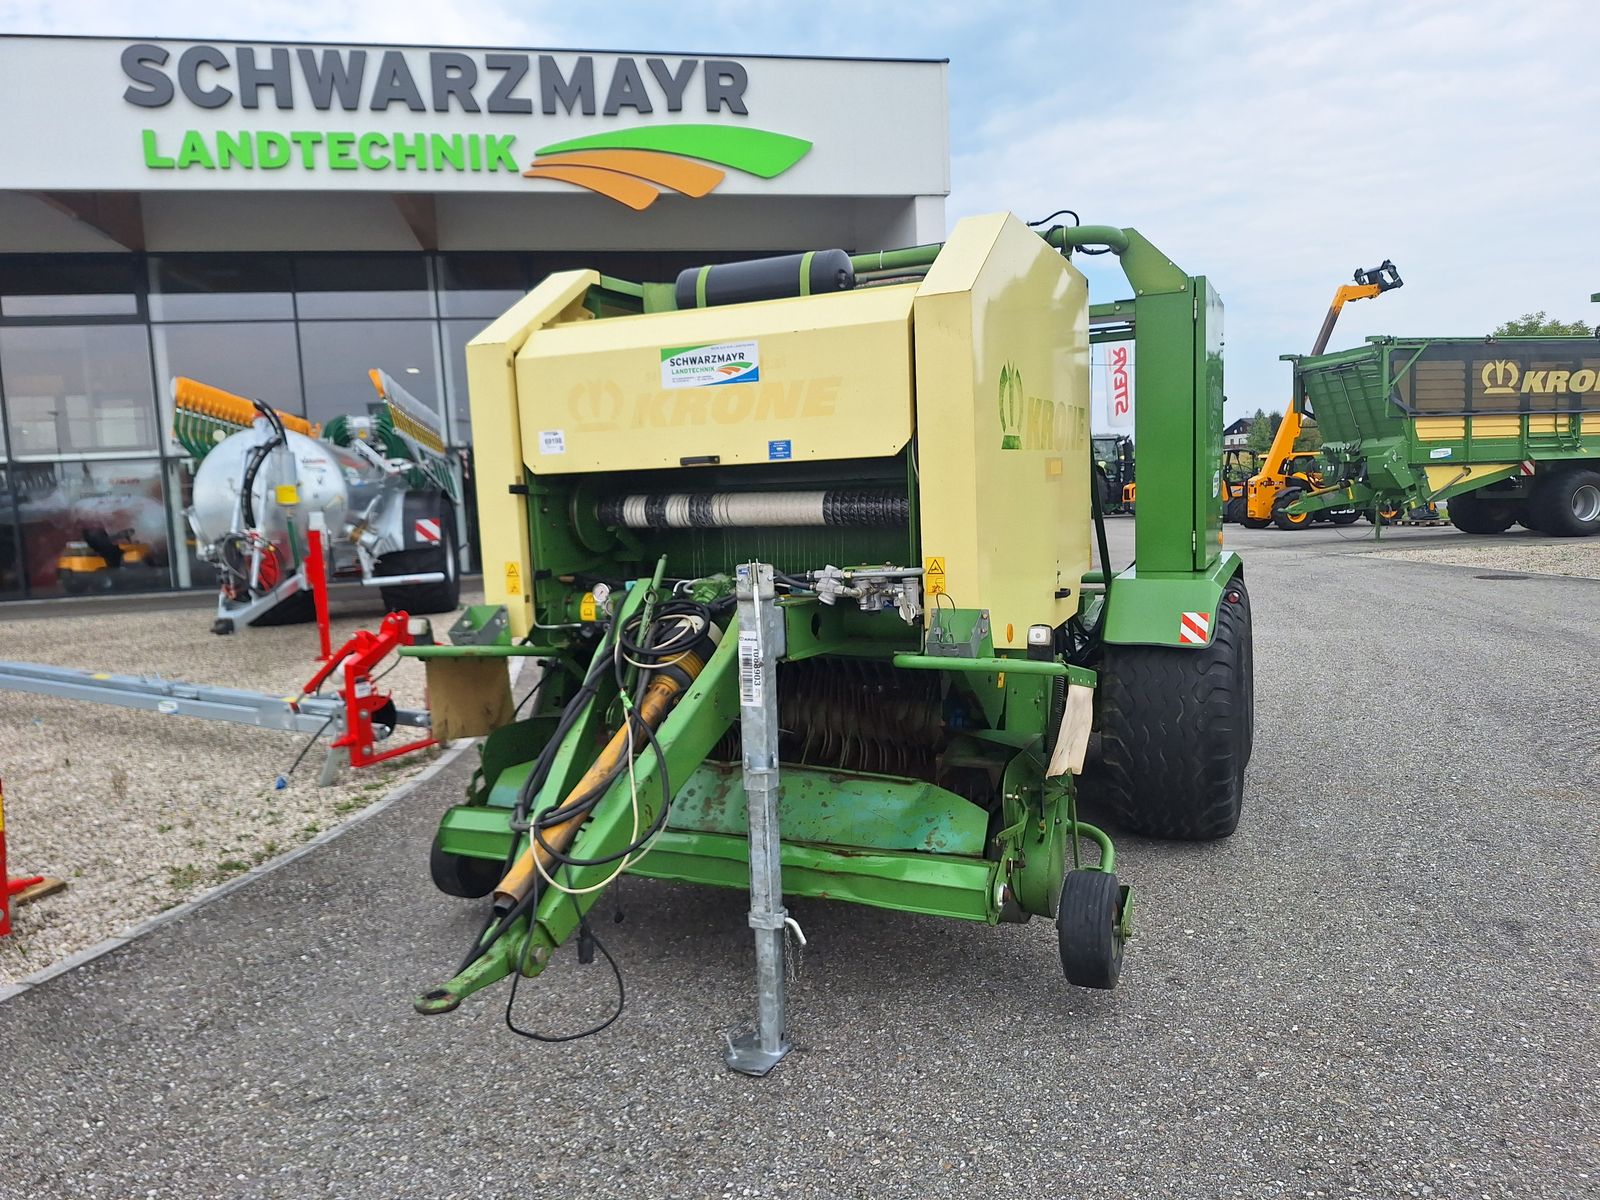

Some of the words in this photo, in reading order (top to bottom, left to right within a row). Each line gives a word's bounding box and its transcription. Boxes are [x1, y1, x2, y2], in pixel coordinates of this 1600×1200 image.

[121, 43, 749, 116] SCHWARZMAYR
[142, 129, 519, 172] LANDTECHNIK
[669, 352, 745, 367] SCHWARZMAYR
[671, 366, 715, 375] LANDTECHNIK
[1520, 369, 1600, 393] KRO
[629, 377, 842, 429] KRONE
